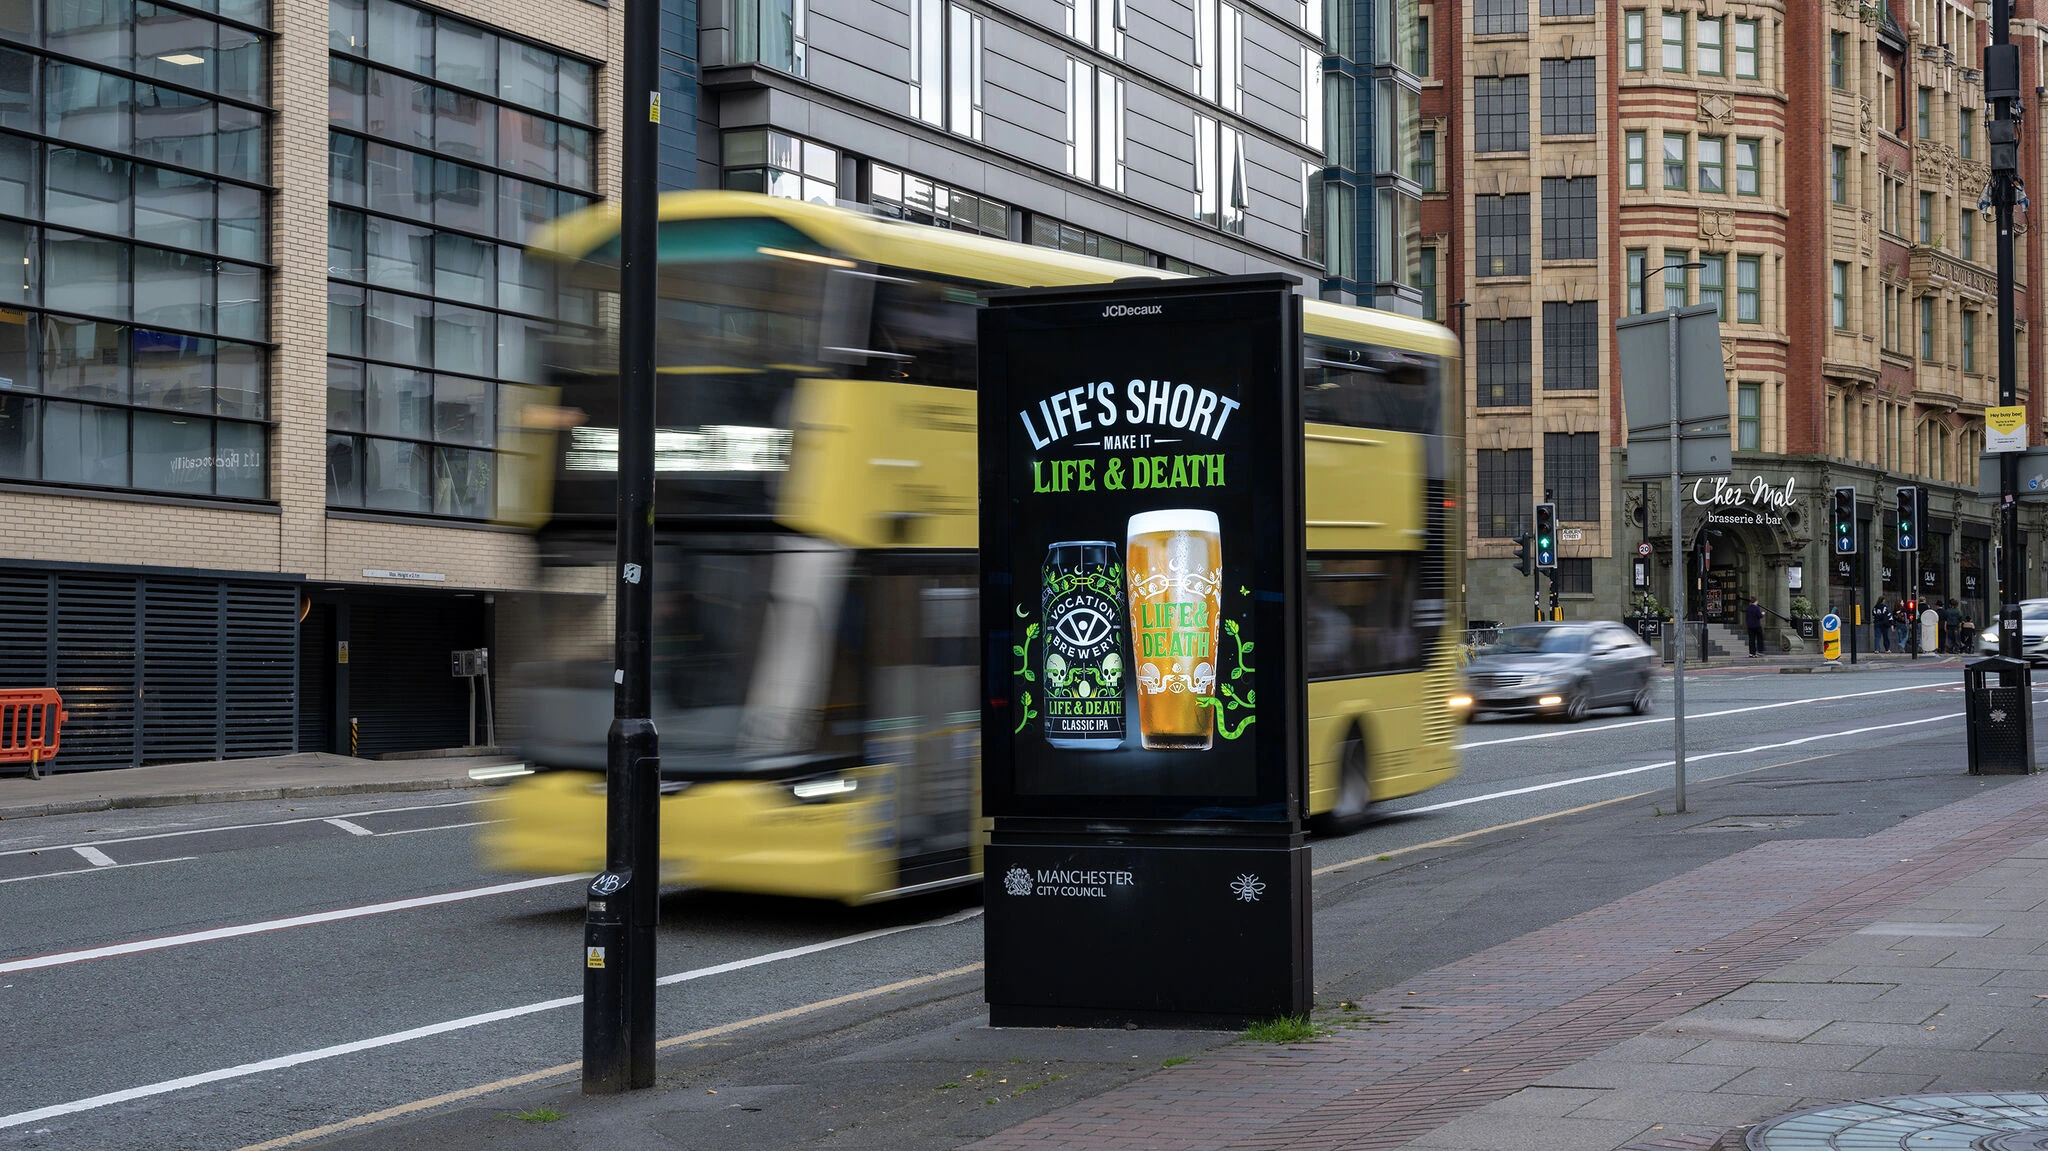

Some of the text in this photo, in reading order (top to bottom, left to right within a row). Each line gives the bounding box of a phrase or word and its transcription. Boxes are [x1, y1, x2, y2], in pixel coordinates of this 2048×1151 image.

[1102, 305, 1162, 317] JCDecaux
[1019, 381, 1118, 450] LIFE'S
[1126, 379, 1241, 441] SHORT
[1104, 434, 1151, 450] MAKE IT
[1033, 453, 1226, 493] LIFE & DEATH
[1750, 475, 1797, 512] Mal
[1708, 511, 1782, 525] brasserie & bar
[1051, 595, 1116, 620] VOCATION
[1052, 634, 1115, 659] BREWERY
[1142, 631, 1210, 658] DEATH
[1049, 700, 1122, 715] LIFE & DEATH
[1062, 719, 1109, 730] CLASSIC IPA
[1037, 869, 1134, 885] MANCHESTER
[1036, 886, 1107, 897] CITY COUNCIL
